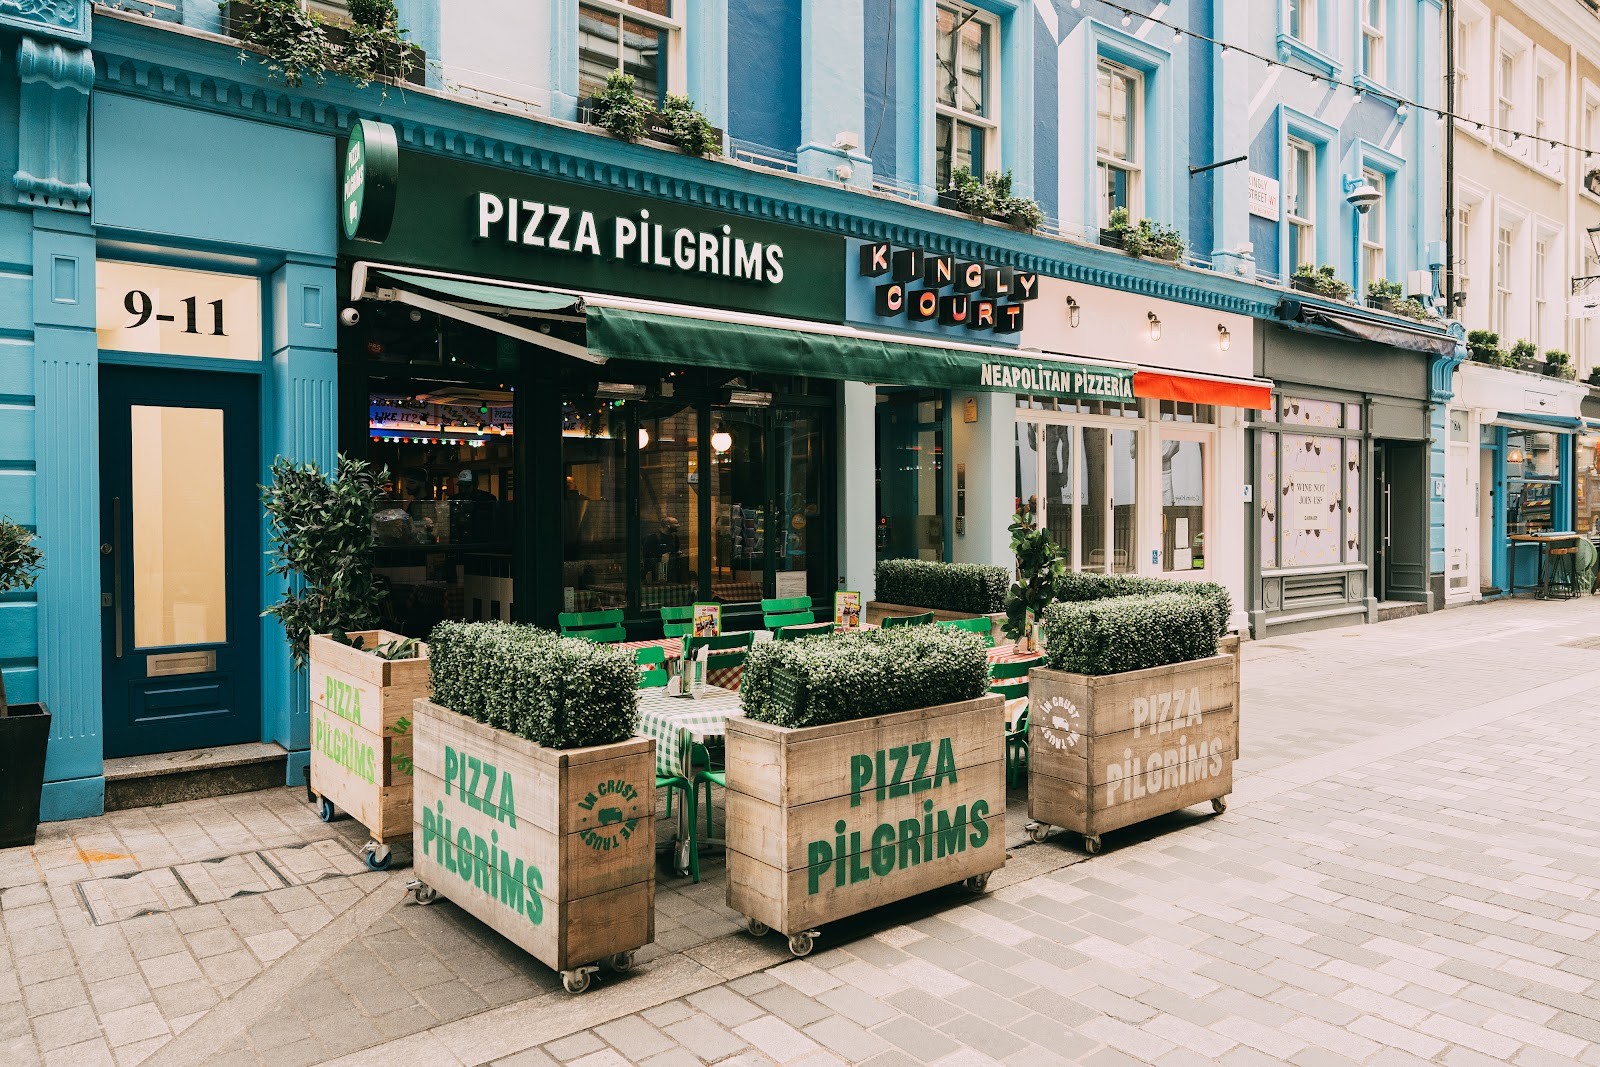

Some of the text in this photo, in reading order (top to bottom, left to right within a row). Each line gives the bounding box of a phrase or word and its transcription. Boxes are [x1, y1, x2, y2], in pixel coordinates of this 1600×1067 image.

[478, 191, 601, 256] PIZZA
[872, 244, 1036, 298] KINGLY
[124, 290, 229, 336] 9-11
[887, 285, 1020, 330] COURT
[374, 411, 398, 421] LIKE
[1296, 483, 1325, 492] WINE NOT
[1299, 495, 1312, 505] JOIN
[326, 675, 362, 726] PIZZA
[1040, 696, 1080, 718] IN CRUST
[1133, 686, 1203, 738] PIZZA
[390, 716, 412, 734] IN
[1040, 725, 1081, 750] WE TRUST
[445, 745, 517, 830] PIZZA
[851, 737, 958, 807] PIZZA
[578, 779, 638, 810] IN CRUST
[580, 827, 620, 851] TRUST
